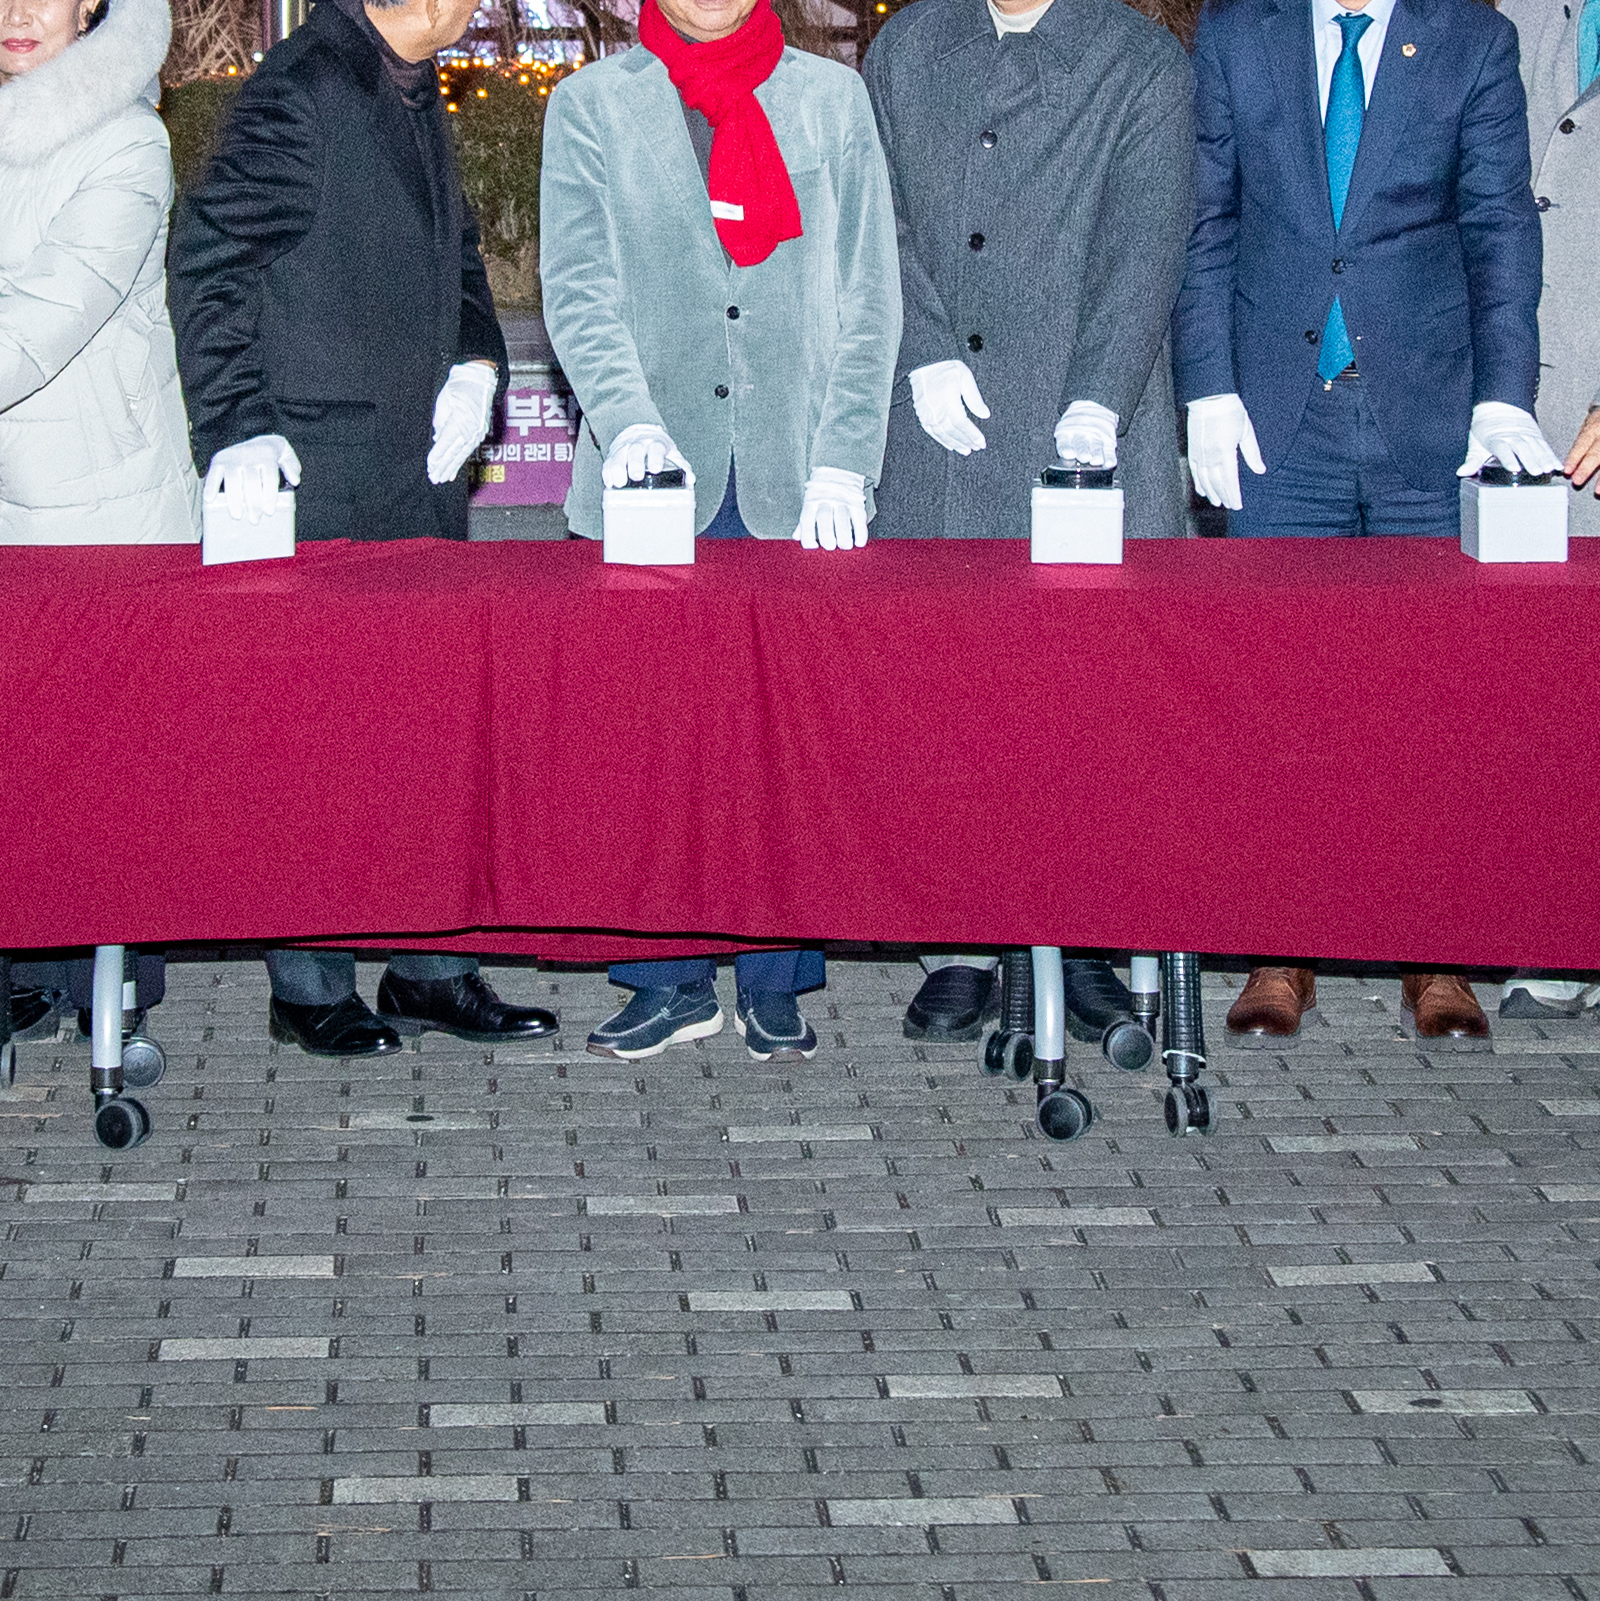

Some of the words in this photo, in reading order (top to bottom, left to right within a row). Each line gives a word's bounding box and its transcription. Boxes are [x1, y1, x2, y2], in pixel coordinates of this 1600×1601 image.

[506, 394, 577, 437] 부착
[524, 443, 551, 462] 관리
[554, 442, 574, 462] 등)
